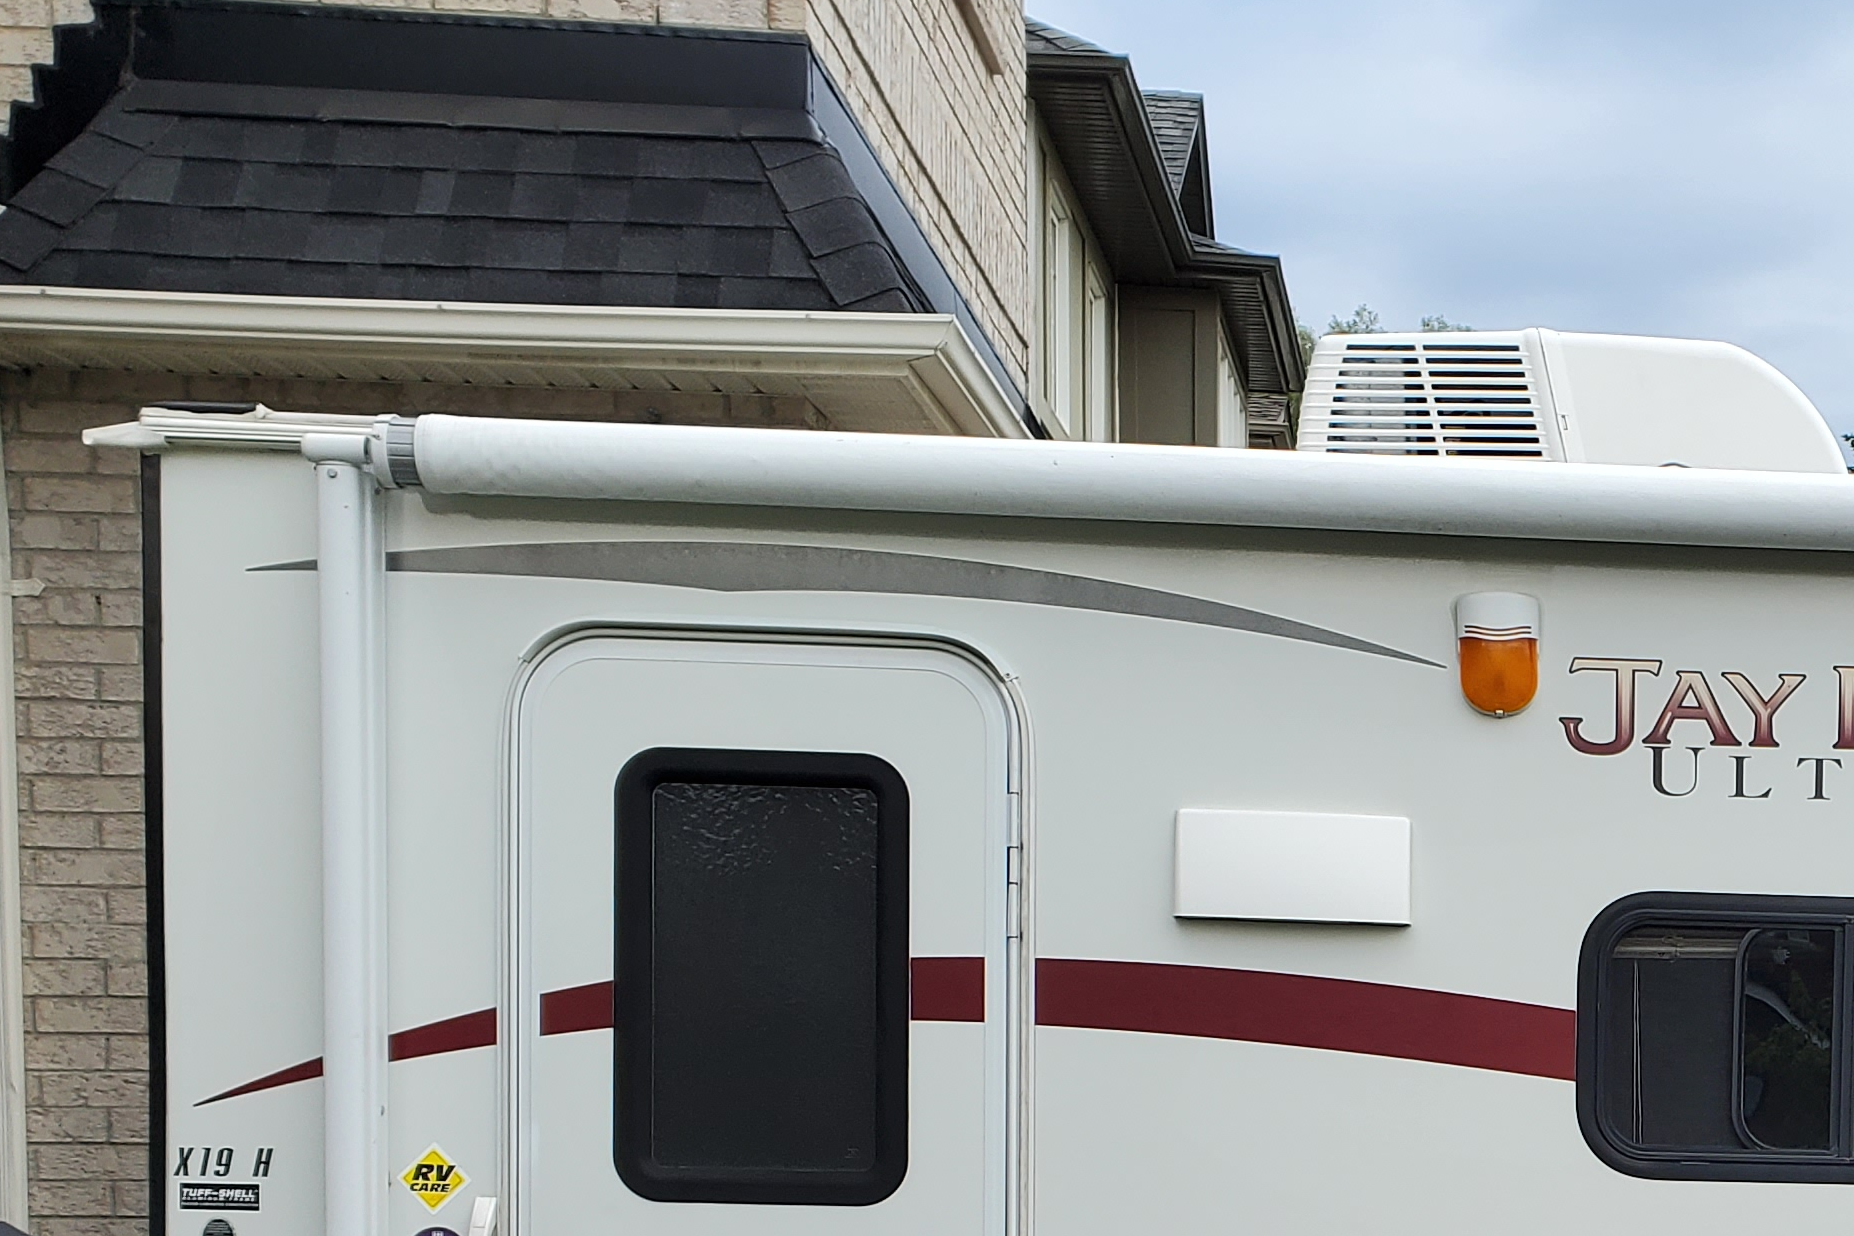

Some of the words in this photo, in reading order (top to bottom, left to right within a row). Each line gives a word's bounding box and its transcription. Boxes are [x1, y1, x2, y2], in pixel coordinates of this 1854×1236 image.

[1558, 656, 1807, 756] JAY
[173, 1147, 234, 1177] X19
[252, 1148, 274, 1177] H
[412, 1163, 456, 1182] RV
[181, 1188, 255, 1198] TUFF-SHELL
[409, 1182, 452, 1193] CARE
